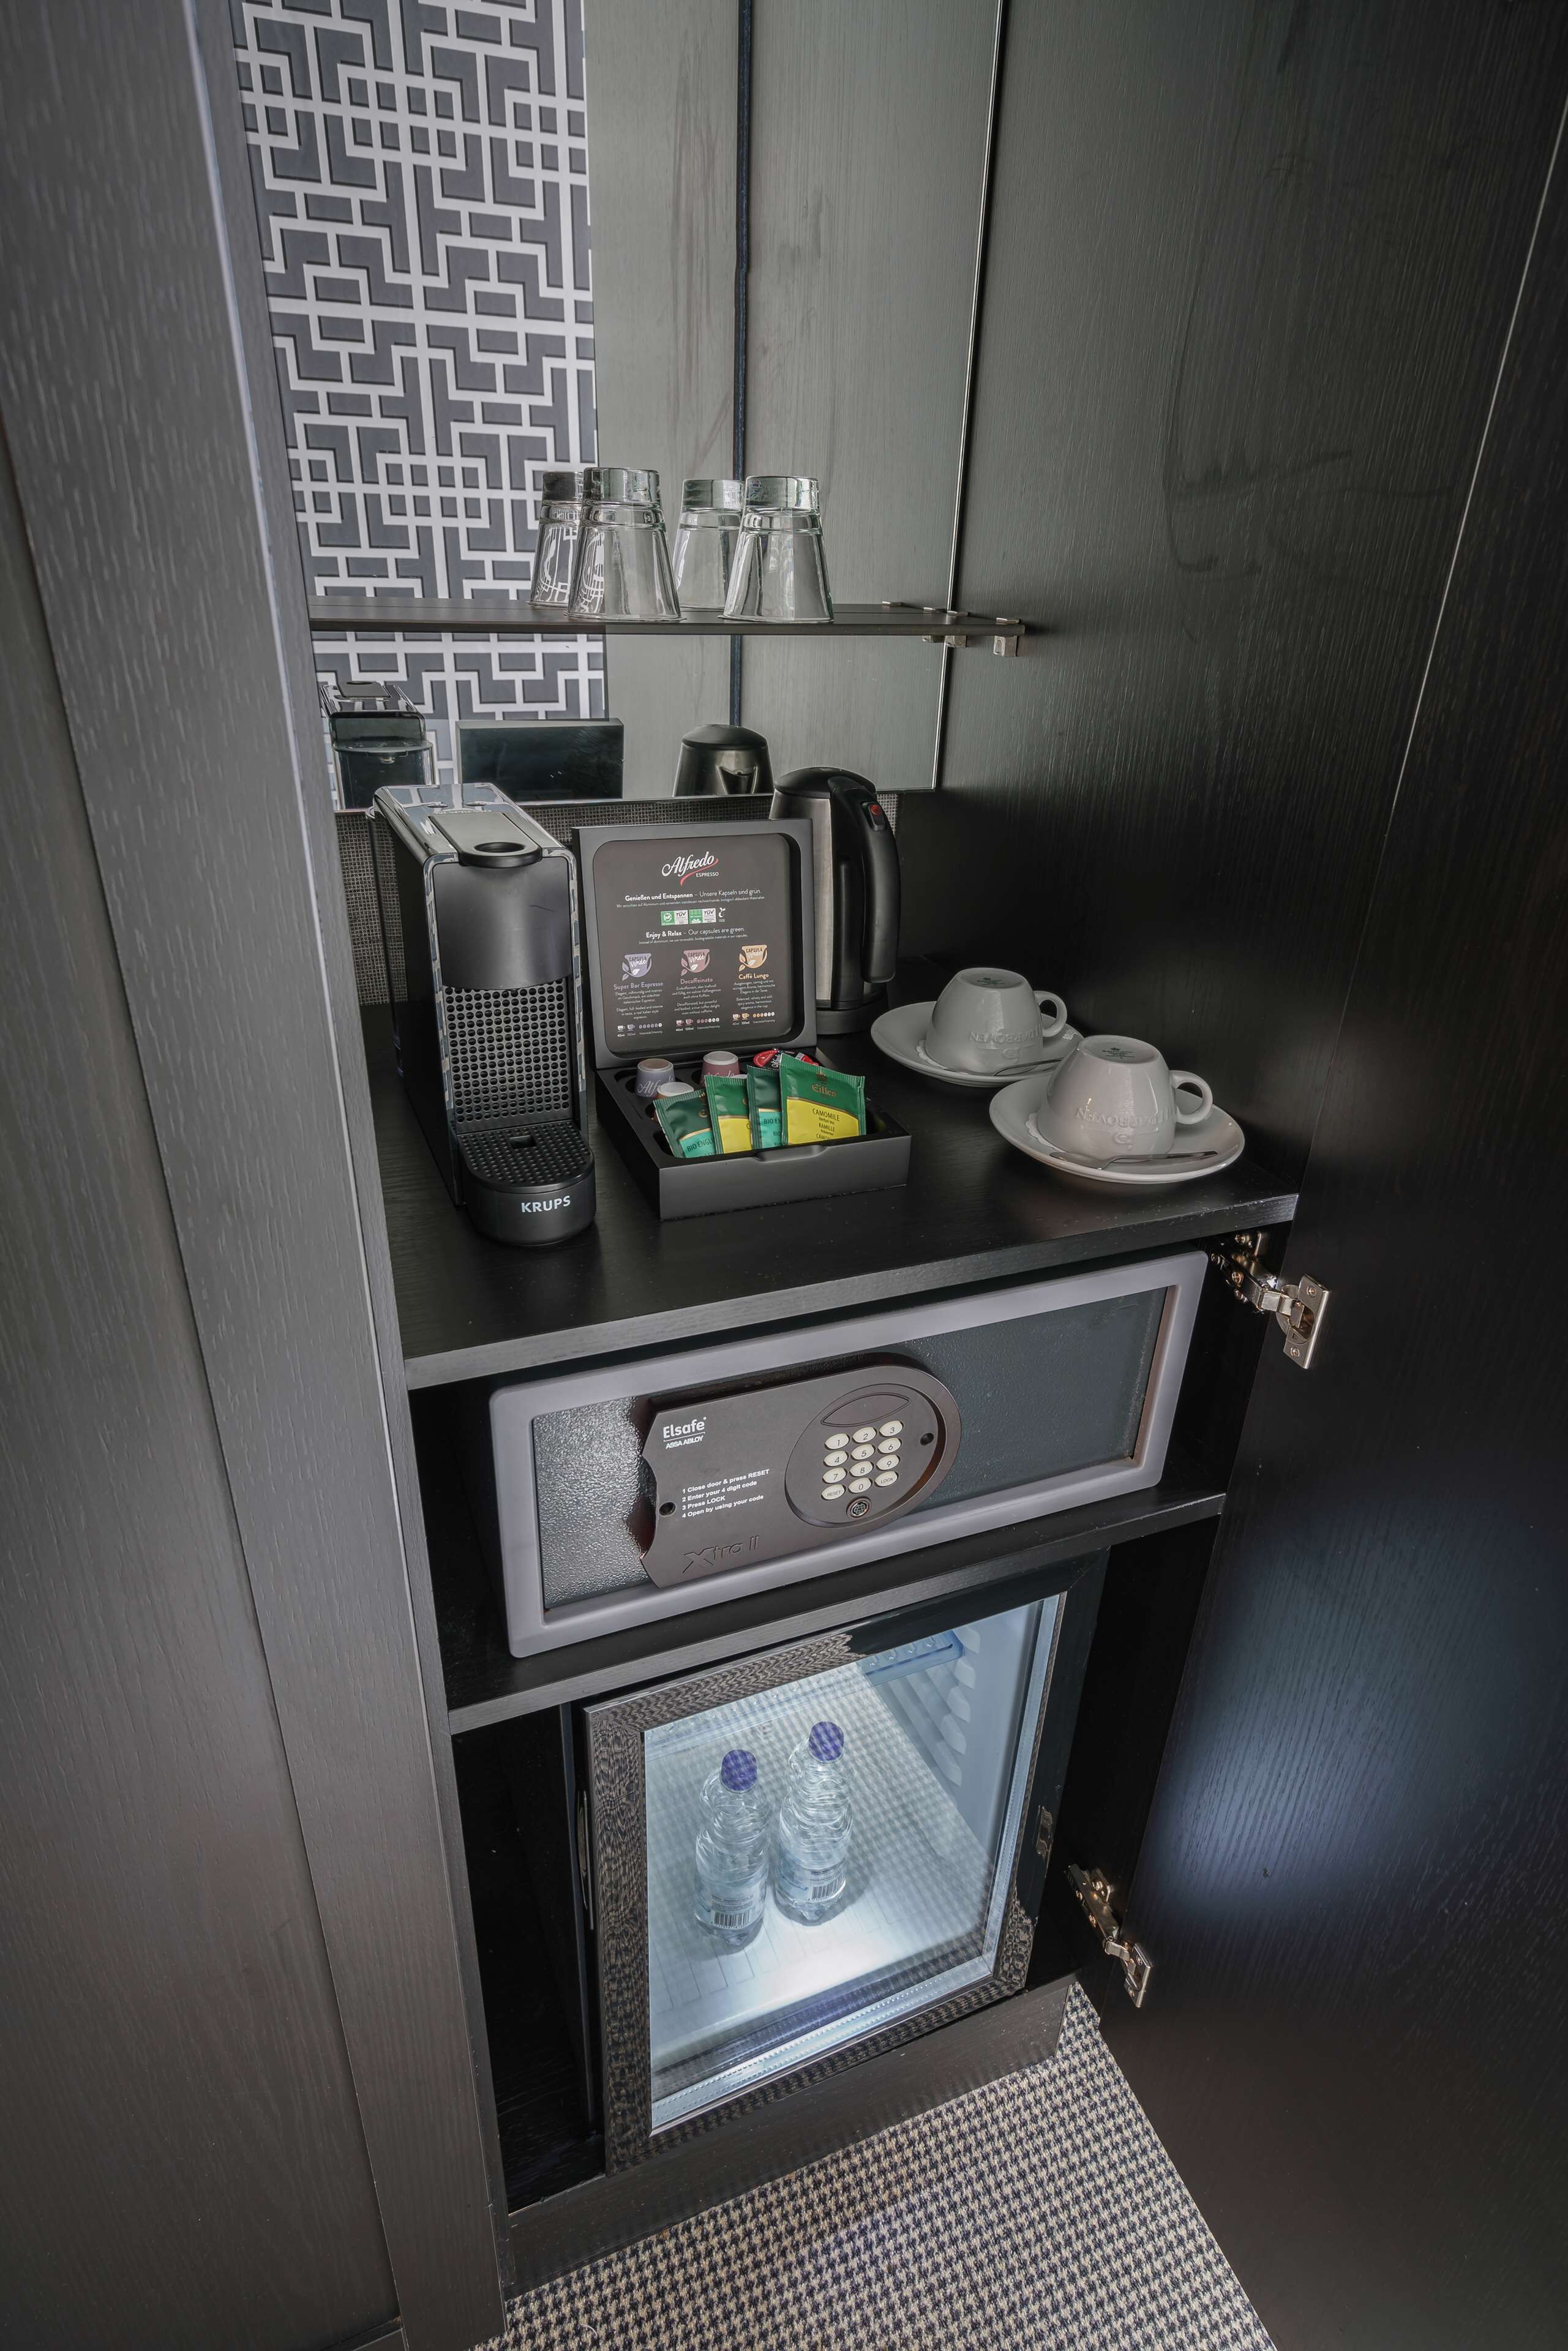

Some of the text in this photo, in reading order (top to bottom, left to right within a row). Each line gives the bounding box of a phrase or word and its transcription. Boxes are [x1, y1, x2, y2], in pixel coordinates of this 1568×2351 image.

[661, 851, 715, 877] Alfredo
[646, 931, 660, 940] Enjoy
[812, 1084, 837, 1097] Eilles
[812, 1108, 840, 1122] CAMOMILE
[819, 1123, 835, 1132] KAMILLE
[686, 1143, 697, 1152] BIO
[521, 1195, 571, 1213] KRUPS
[663, 1419, 705, 1439] Elsafe
[666, 1436, 703, 1449] ASSA ABLOY
[730, 1475, 746, 1483] press
[748, 1469, 769, 1478] RESET
[727, 1483, 741, 1491] digit
[707, 1496, 726, 1504] LOCK
[688, 1509, 704, 1517] Open
[682, 1542, 743, 1573] Xtra
